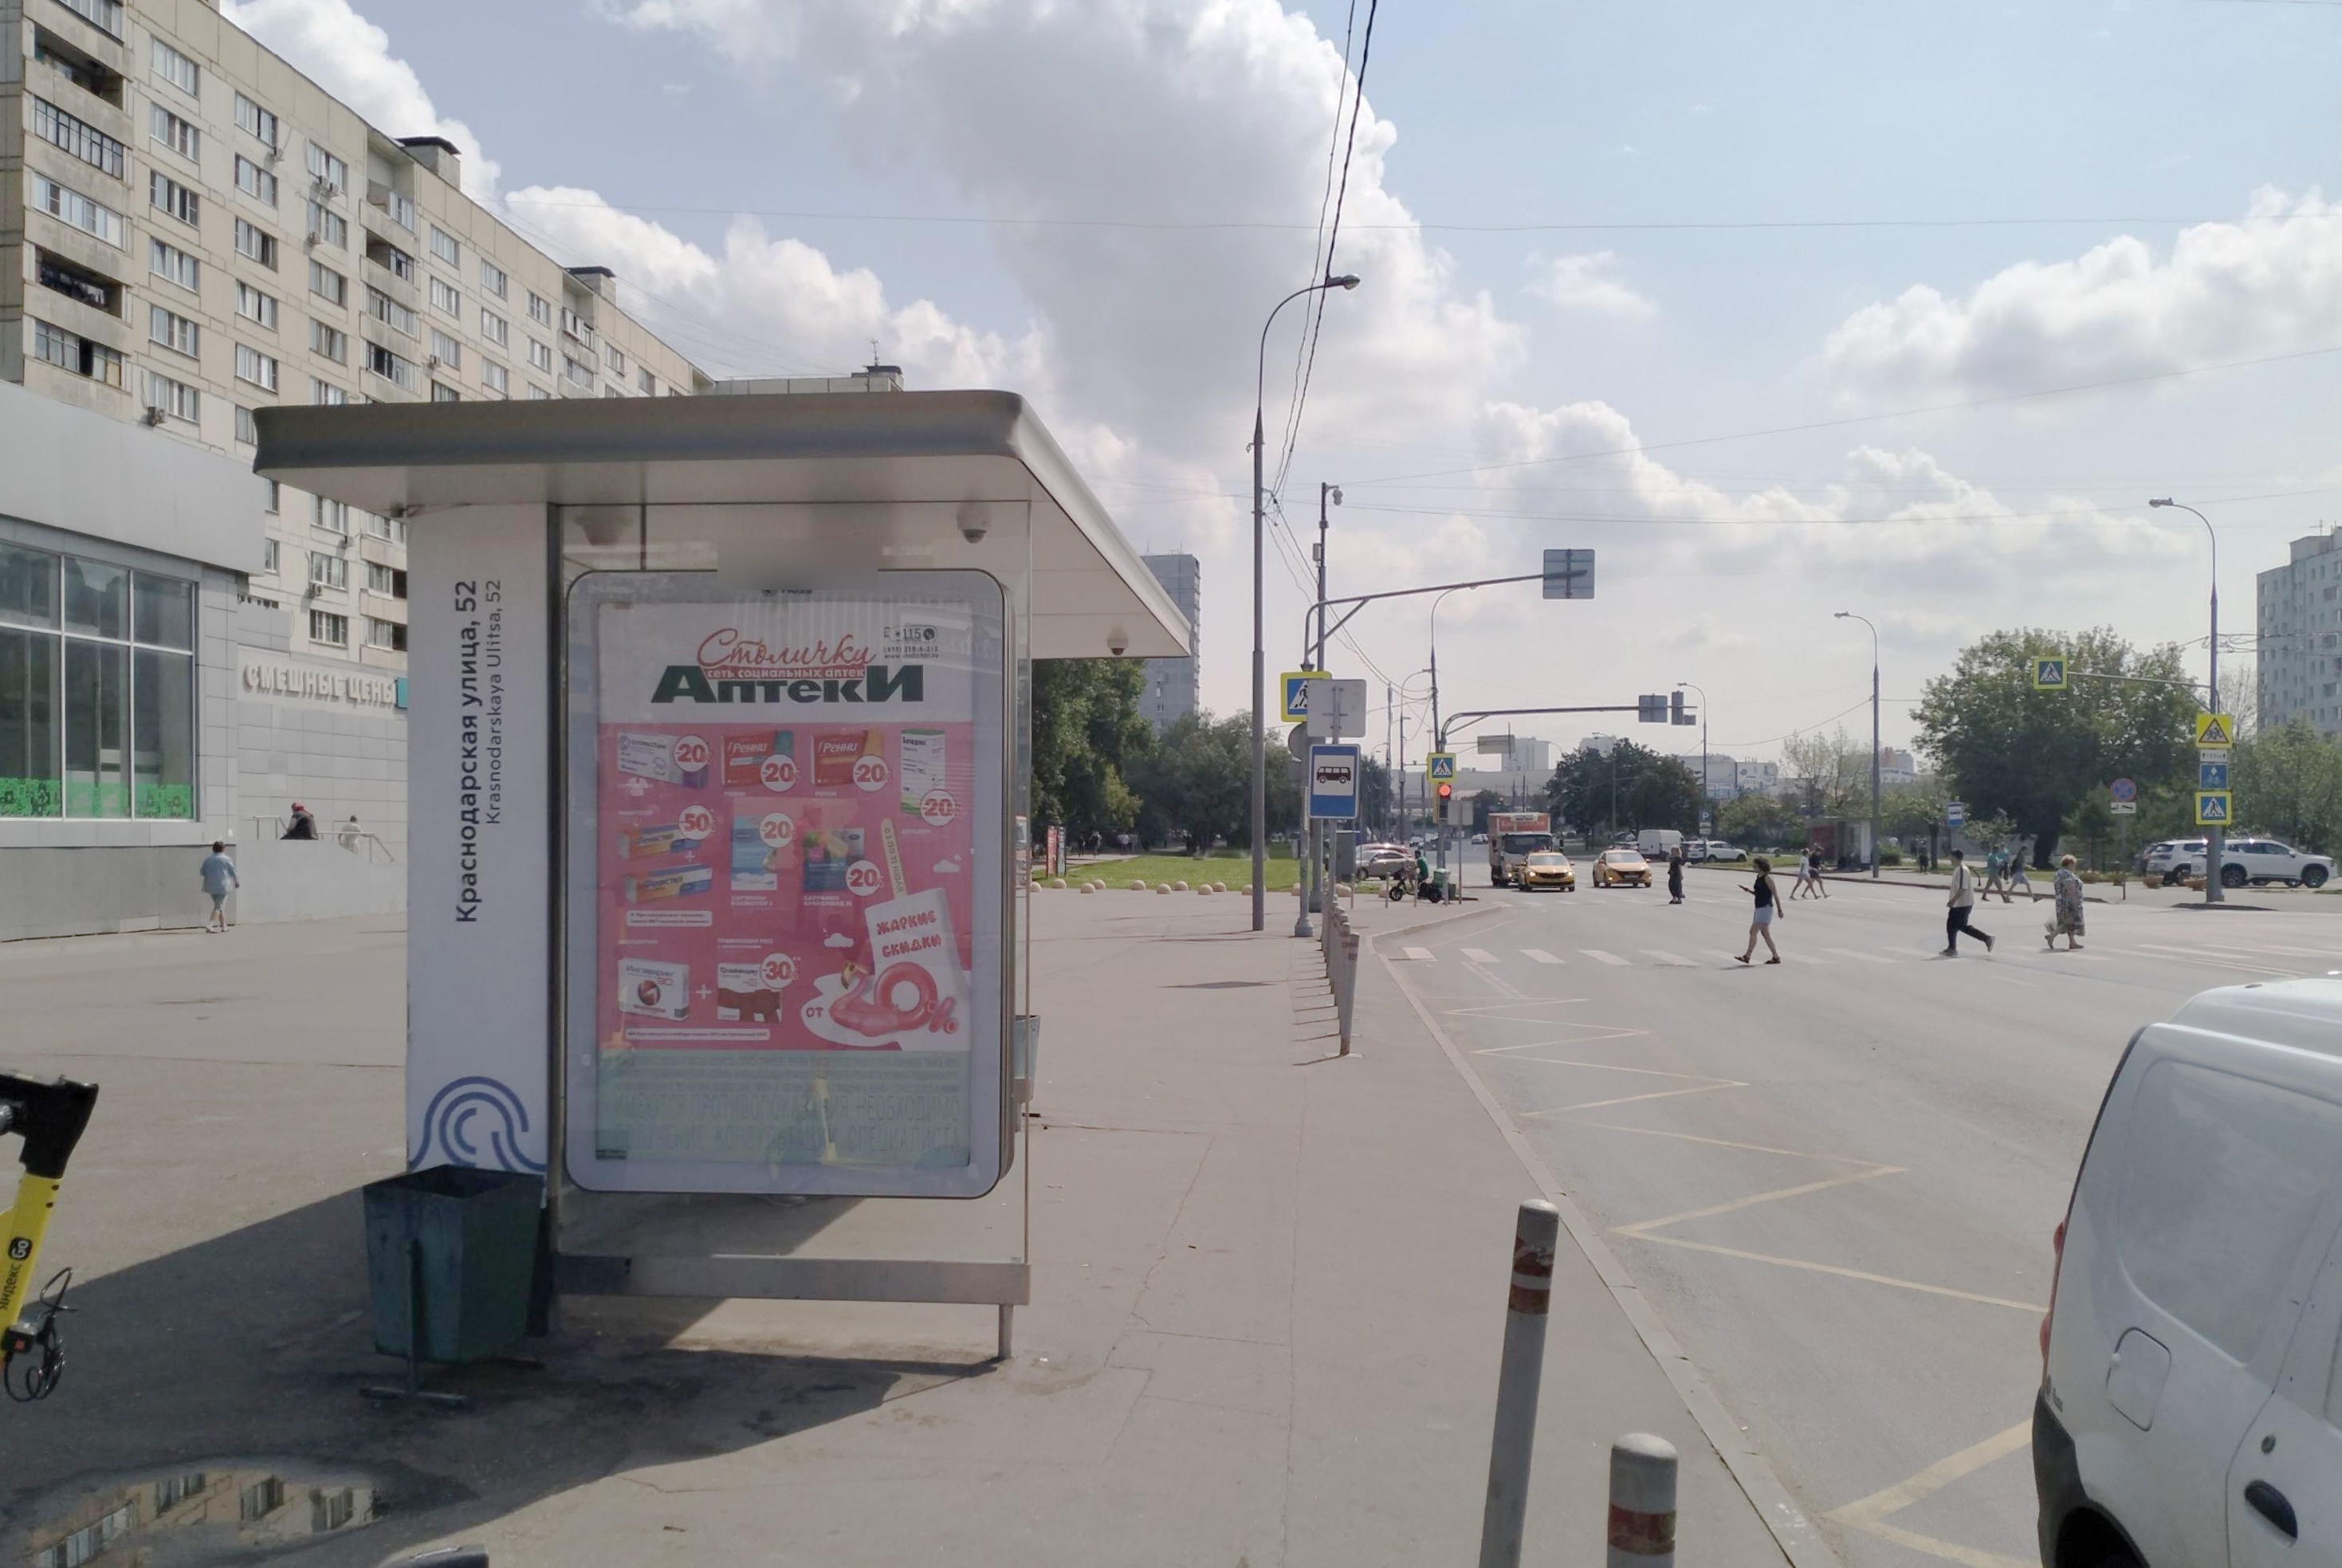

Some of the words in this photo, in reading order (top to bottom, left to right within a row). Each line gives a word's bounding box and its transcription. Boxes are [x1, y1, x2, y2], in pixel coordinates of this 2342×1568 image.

[455, 580, 477, 612] 52
[486, 580, 501, 601] 52
[486, 609, 503, 668] Ulitsa,
[697, 627, 876, 666] Столички
[461, 619, 483, 707] улица,
[706, 669, 734, 678] сеть
[737, 668, 821, 679] социальных
[825, 668, 865, 678] аптек
[486, 674, 504, 824] Krasnodarskaya
[456, 715, 481, 922] Краснодарская
[876, 910, 937, 935] ЖАРКИЕ
[881, 933, 942, 957] СКИДКИ
[11, 1240, 29, 1259] Go
